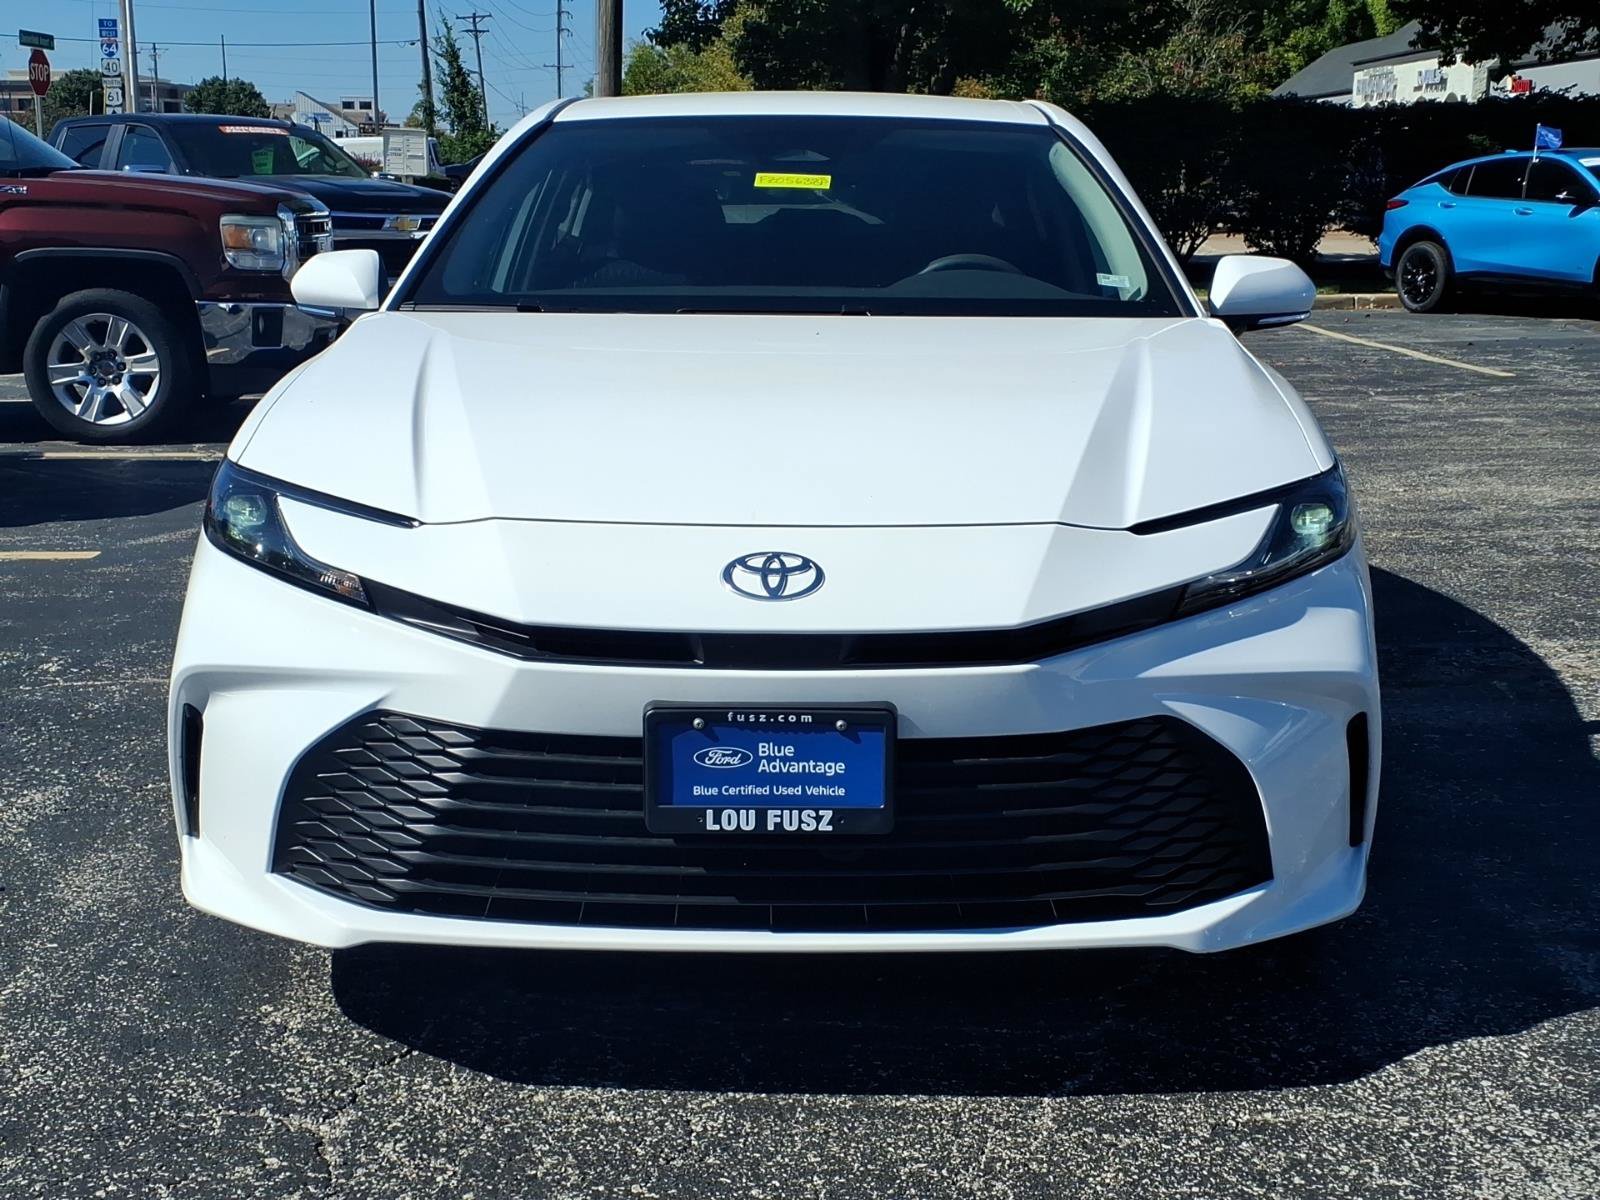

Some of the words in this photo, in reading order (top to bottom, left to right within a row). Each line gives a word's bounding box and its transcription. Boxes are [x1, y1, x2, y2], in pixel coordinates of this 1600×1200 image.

[102, 44, 117, 54] 64
[30, 62, 49, 82] STOP
[104, 62, 118, 73] 40
[107, 91, 120, 102] 61
[727, 712, 813, 723] fusz.com
[758, 743, 795, 757] Blue
[704, 750, 741, 765] Ford
[757, 759, 846, 776] Advantage
[693, 785, 719, 796] Blue
[721, 785, 770, 795] Certified
[773, 785, 802, 795] Used
[805, 785, 846, 796] Vehicle
[706, 809, 756, 831] LOU
[767, 809, 833, 831] FUSZ
